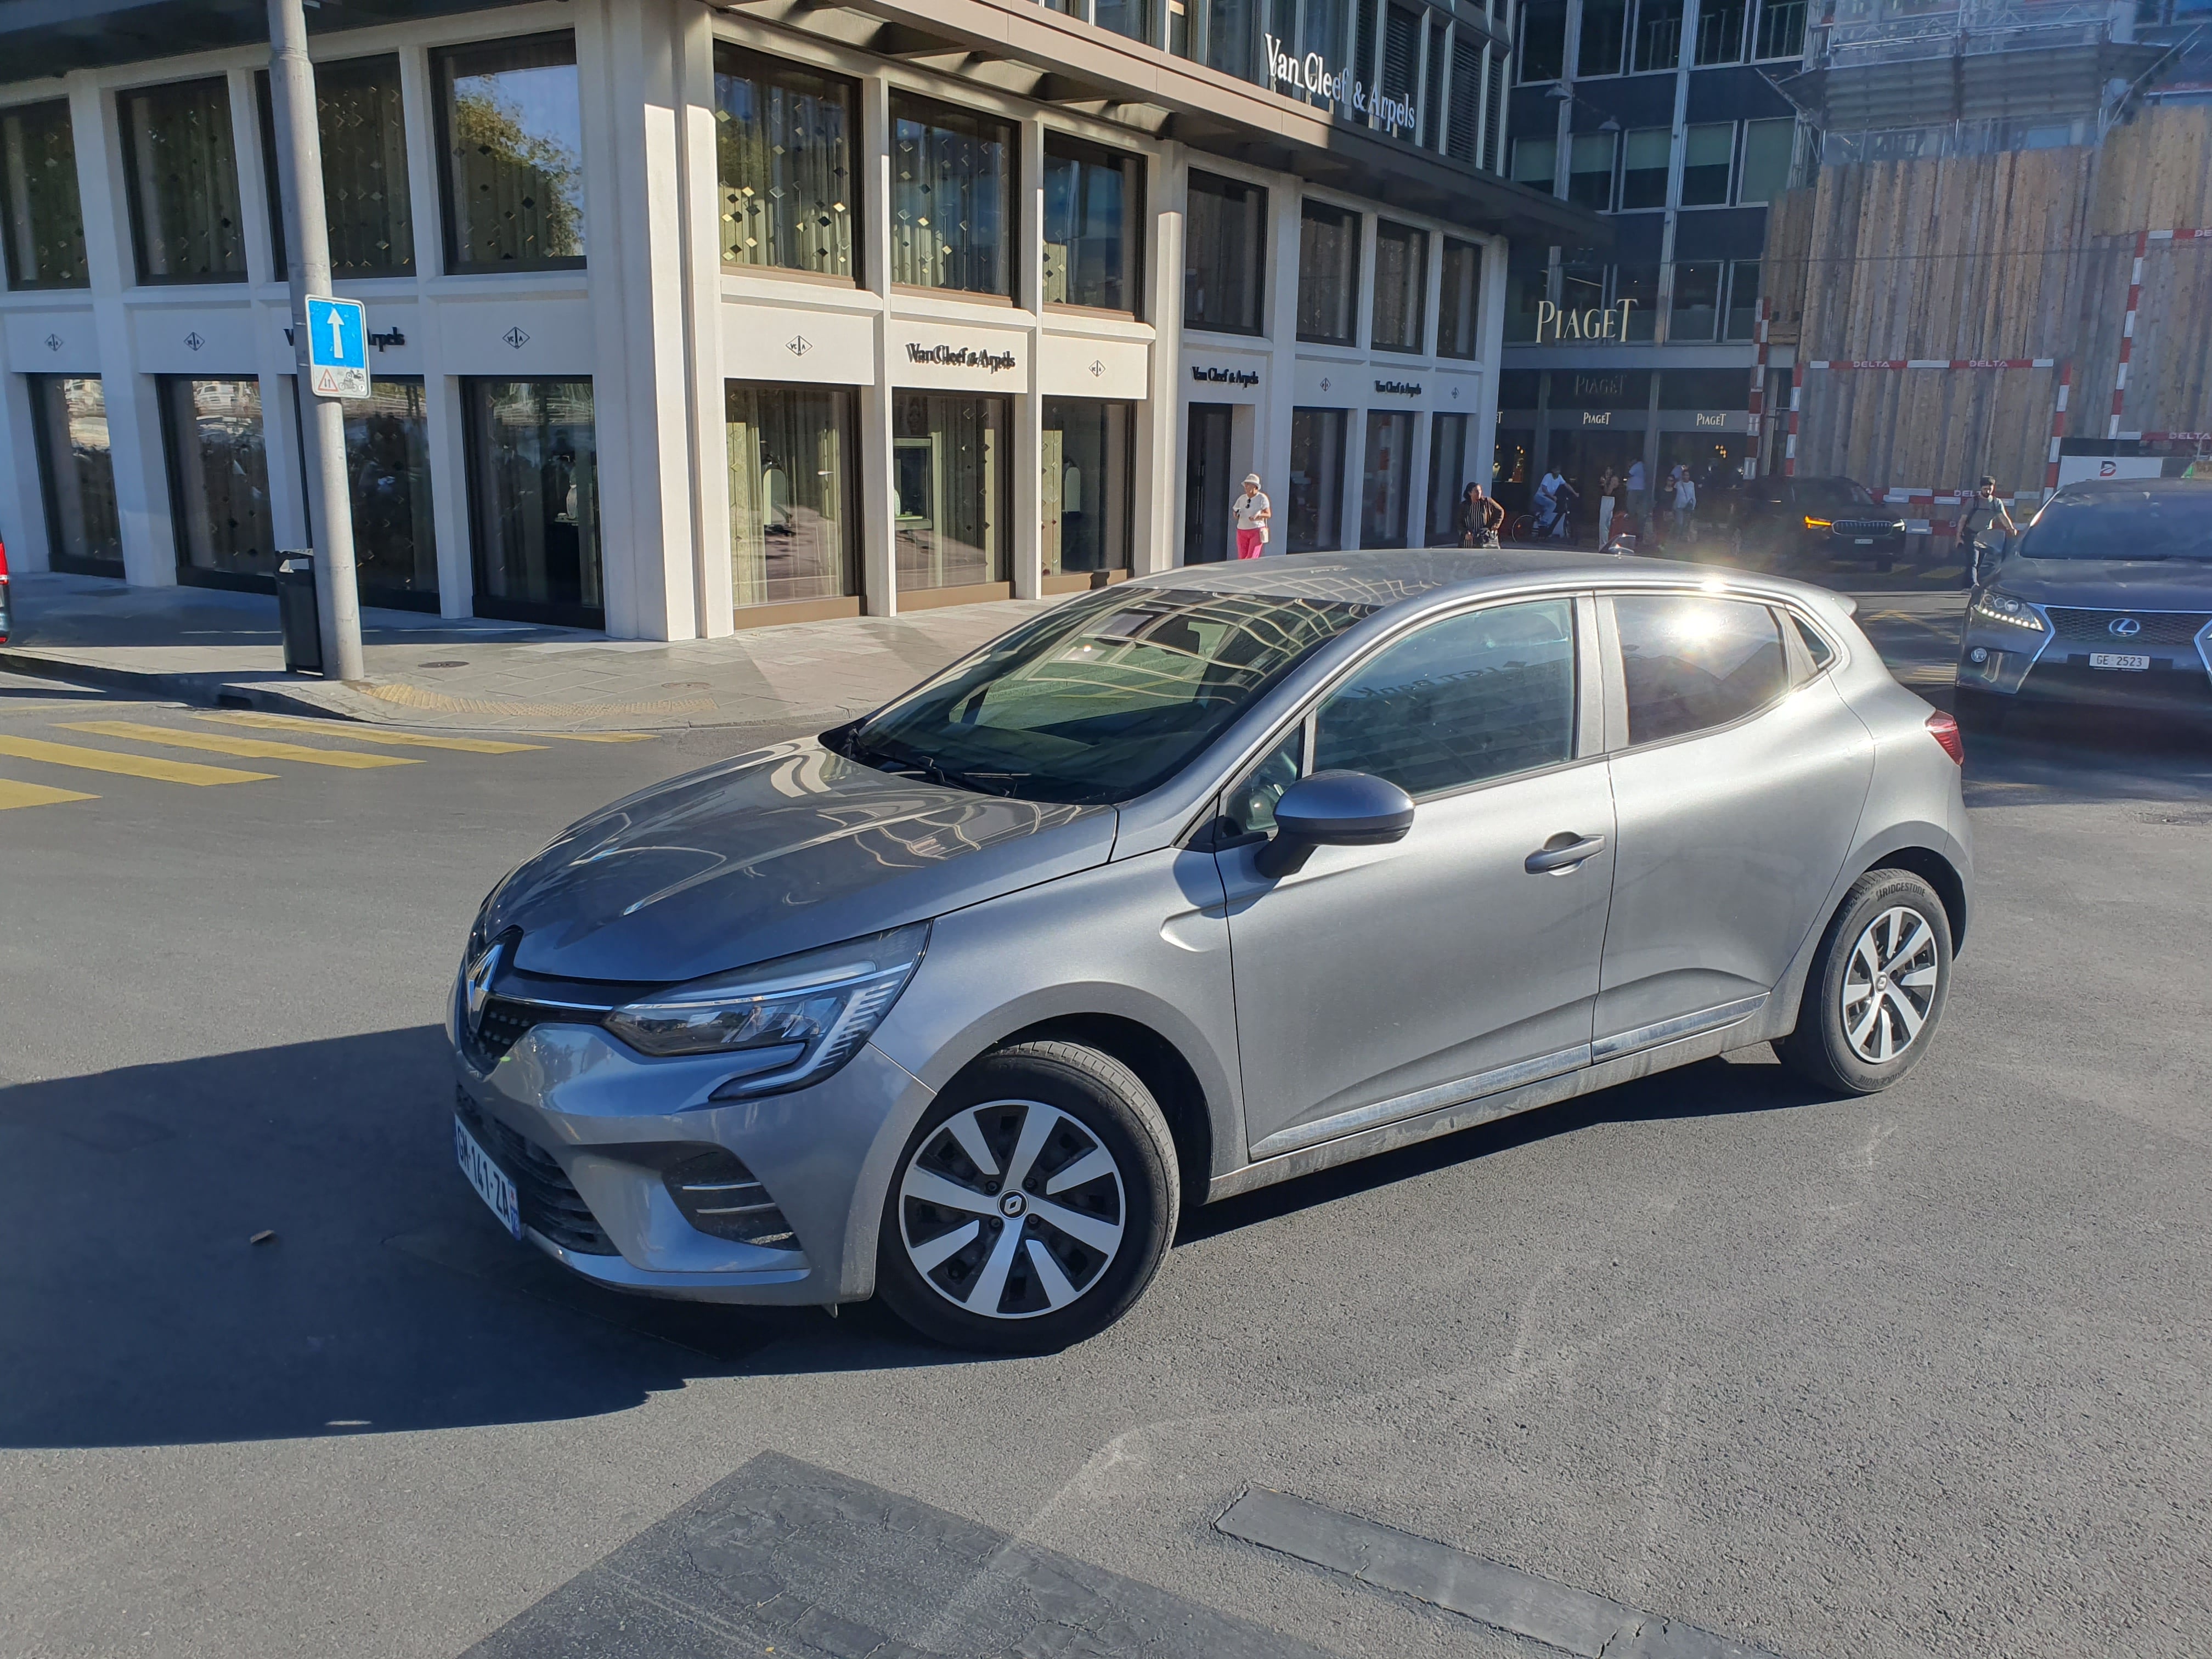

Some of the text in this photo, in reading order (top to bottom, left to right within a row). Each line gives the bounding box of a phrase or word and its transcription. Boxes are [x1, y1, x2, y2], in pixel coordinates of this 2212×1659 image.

[1265, 33, 1415, 132] Van Cleef & Arpels
[1536, 298, 1639, 343] PIAGET
[906, 343, 933, 364] Van
[933, 345, 968, 366] Cleef
[977, 349, 1015, 374] Arpels
[1583, 412, 1611, 425] PIAGET
[1696, 413, 1726, 426] PIAGET
[2097, 655, 2142, 667] GE 2523
